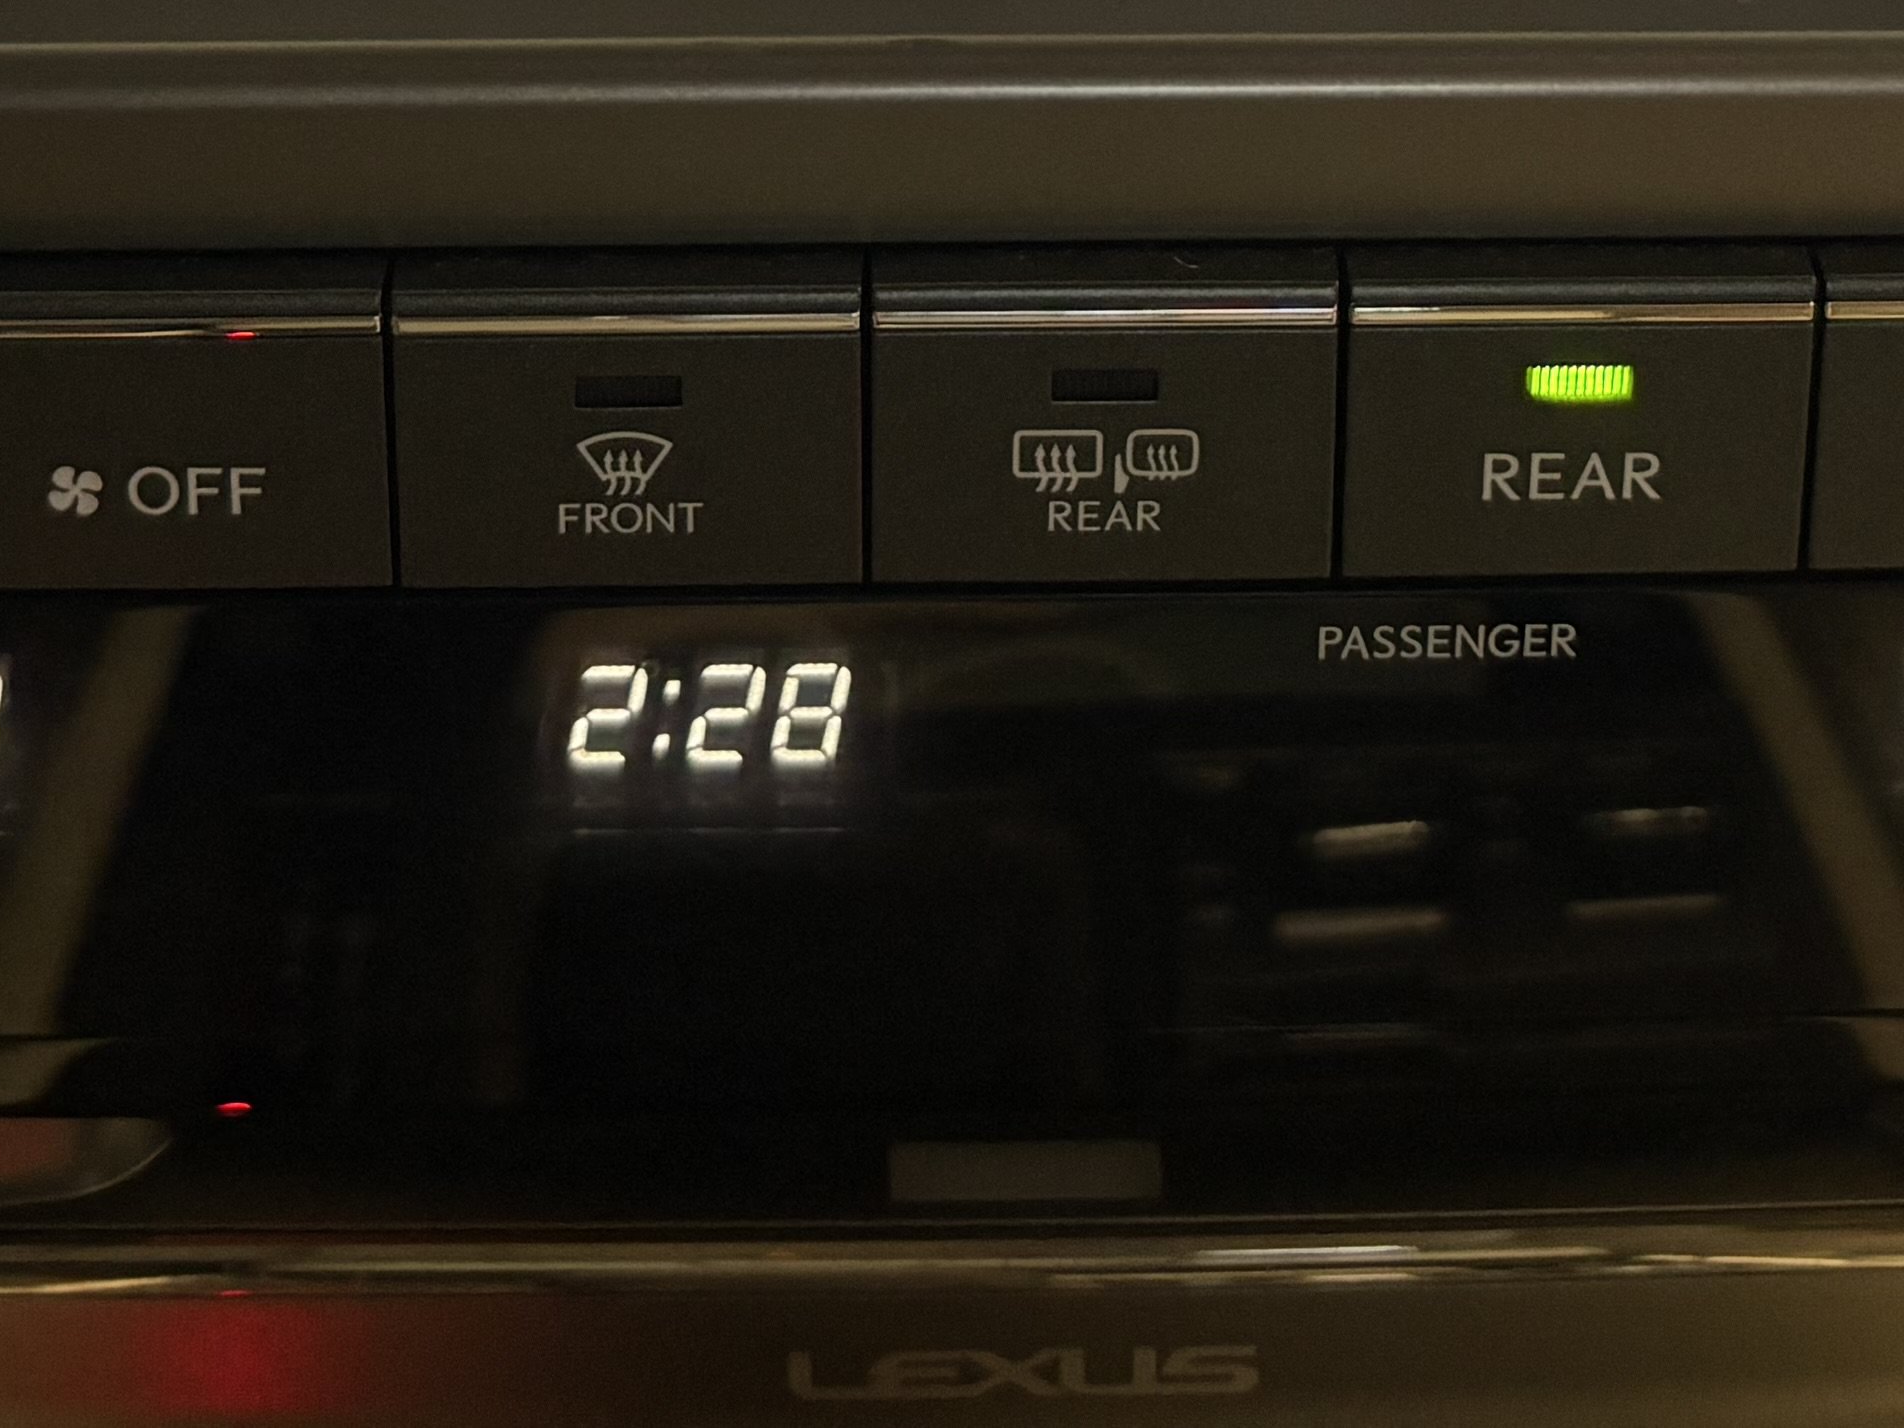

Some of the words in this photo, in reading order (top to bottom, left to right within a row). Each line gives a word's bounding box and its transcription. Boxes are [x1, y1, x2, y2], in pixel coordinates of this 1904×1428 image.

[126, 466, 266, 516] OFF
[1481, 451, 1662, 502] REAR
[557, 501, 702, 535] FRONT
[1045, 500, 1161, 532] REAR
[1317, 623, 1577, 662] PASSENGER
[566, 663, 852, 765] 2:28
[786, 1346, 1260, 1401] LEXUS
